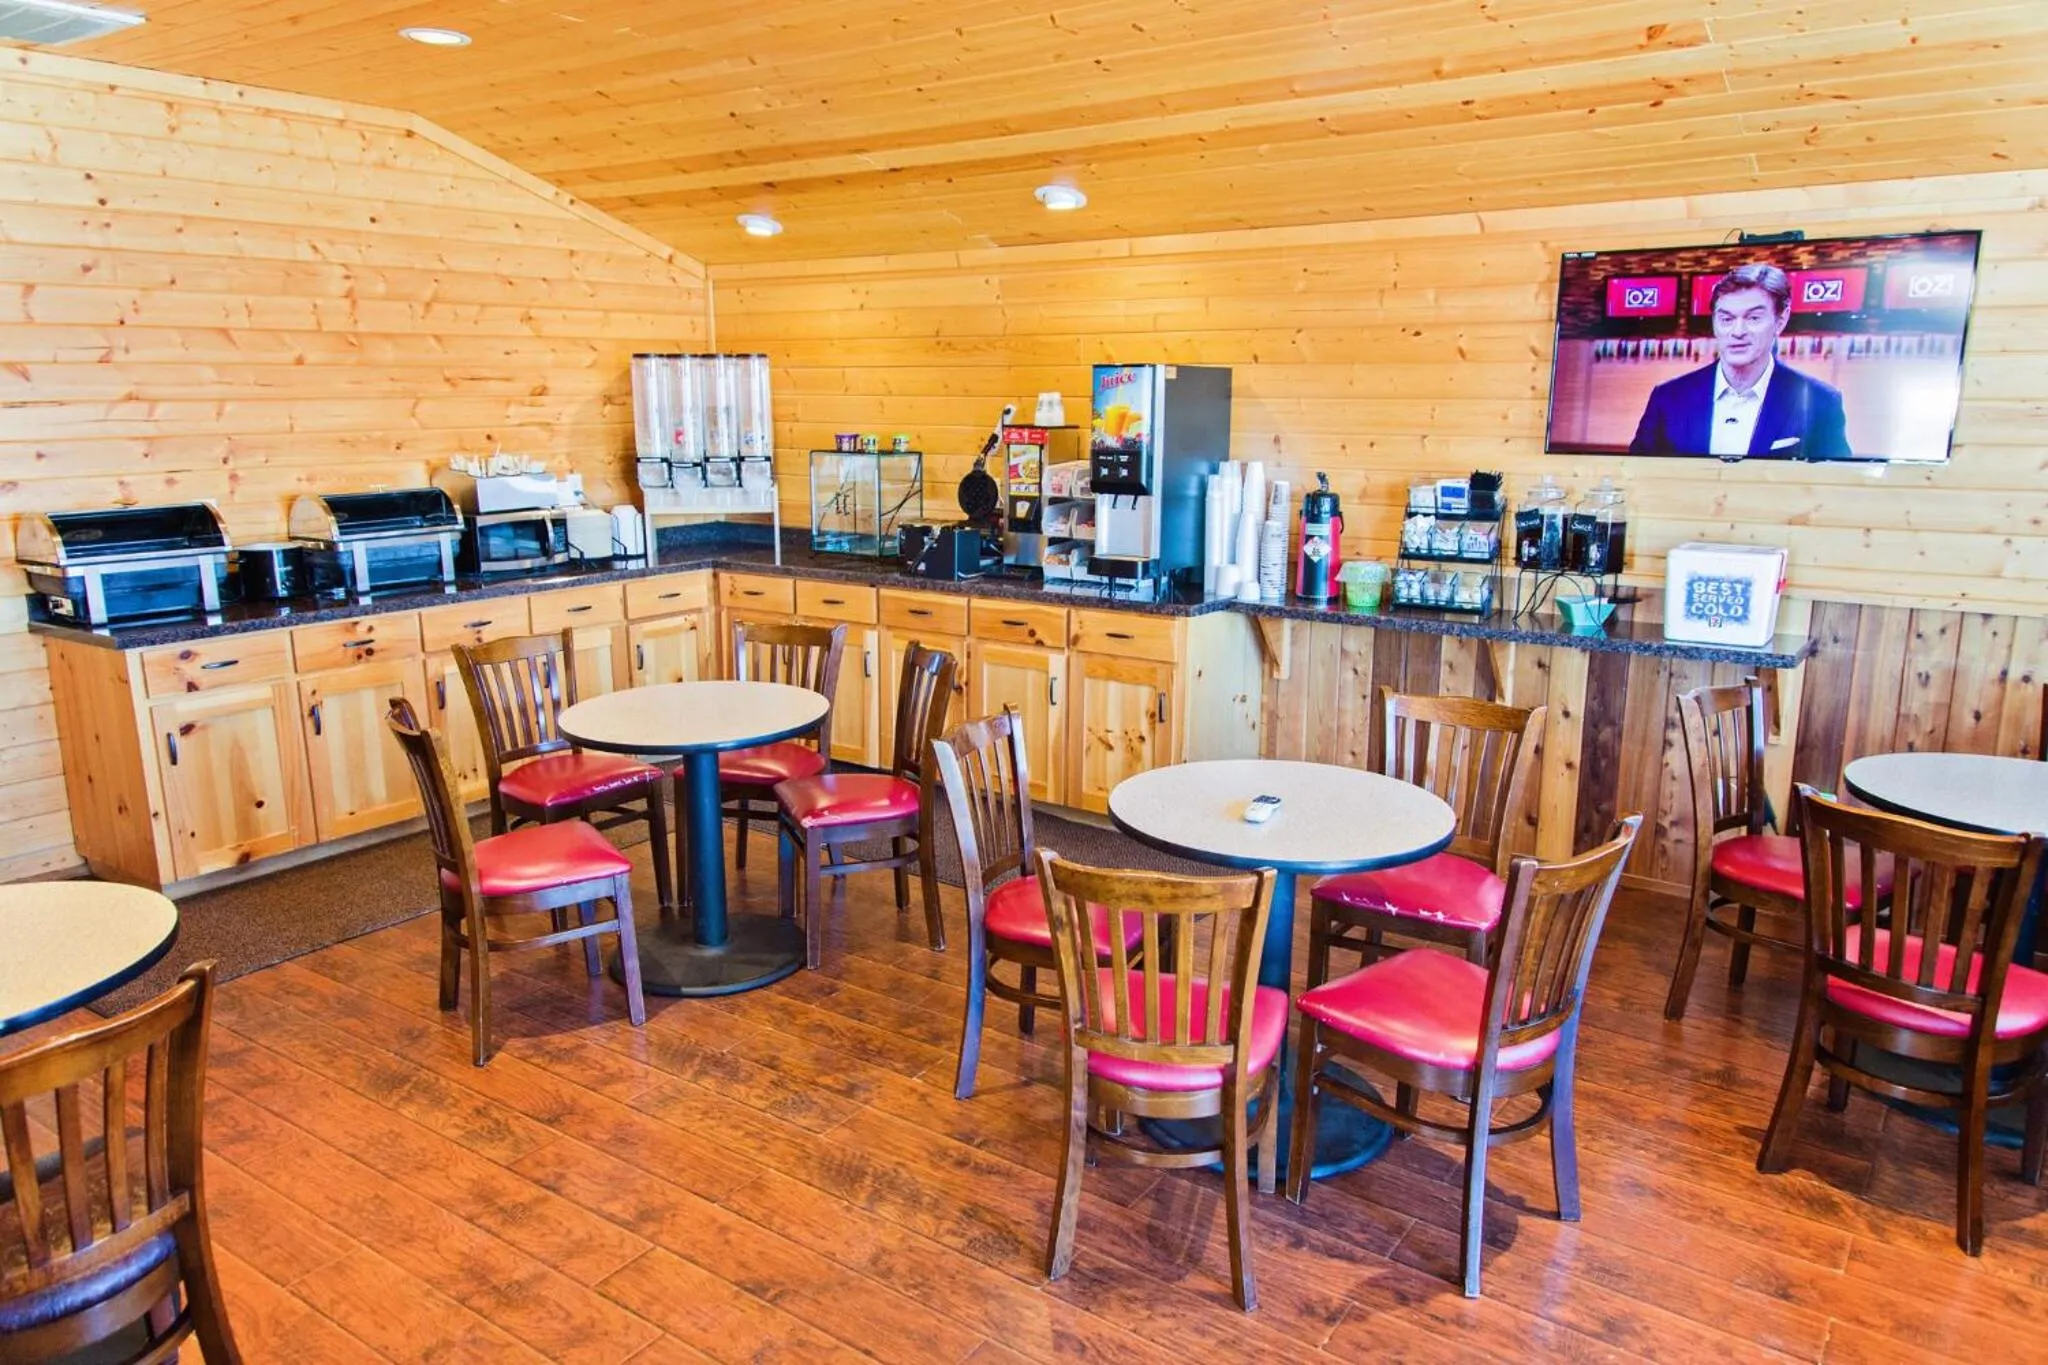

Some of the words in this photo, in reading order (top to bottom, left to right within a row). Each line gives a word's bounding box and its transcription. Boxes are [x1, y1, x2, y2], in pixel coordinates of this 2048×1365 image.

[1806, 281, 1840, 300] OZ
[1912, 276, 1950, 294] OZ
[1627, 288, 1656, 305] OZ
[1692, 581, 1745, 596] BEST
[1690, 602, 1743, 617] COLD
